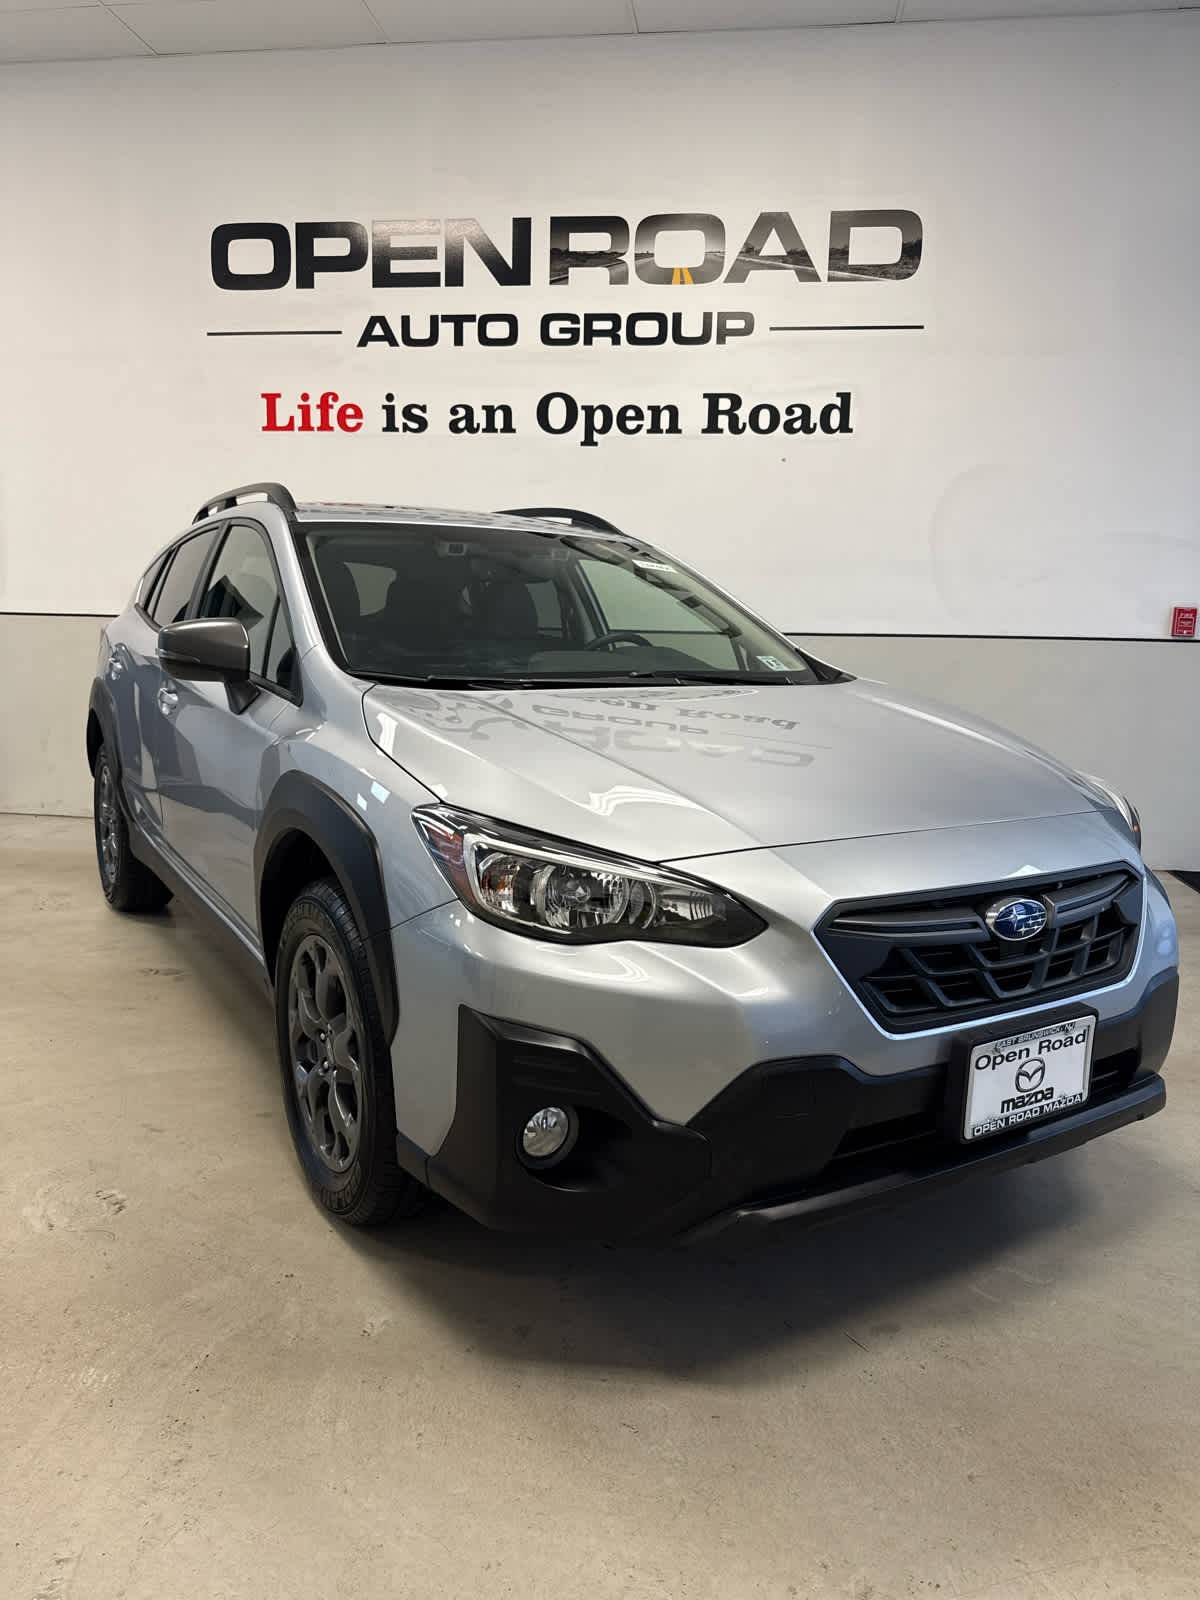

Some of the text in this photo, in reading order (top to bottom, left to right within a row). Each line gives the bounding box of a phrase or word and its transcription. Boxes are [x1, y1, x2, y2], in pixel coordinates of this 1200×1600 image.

[211, 210, 923, 290] OPEN ROAD
[357, 312, 754, 348] AUTO GROUP
[261, 392, 853, 446] Life is an Open Road
[975, 1029, 1086, 1070] Open Road
[974, 1095, 1082, 1136] OPEN ROAD MAZDA
